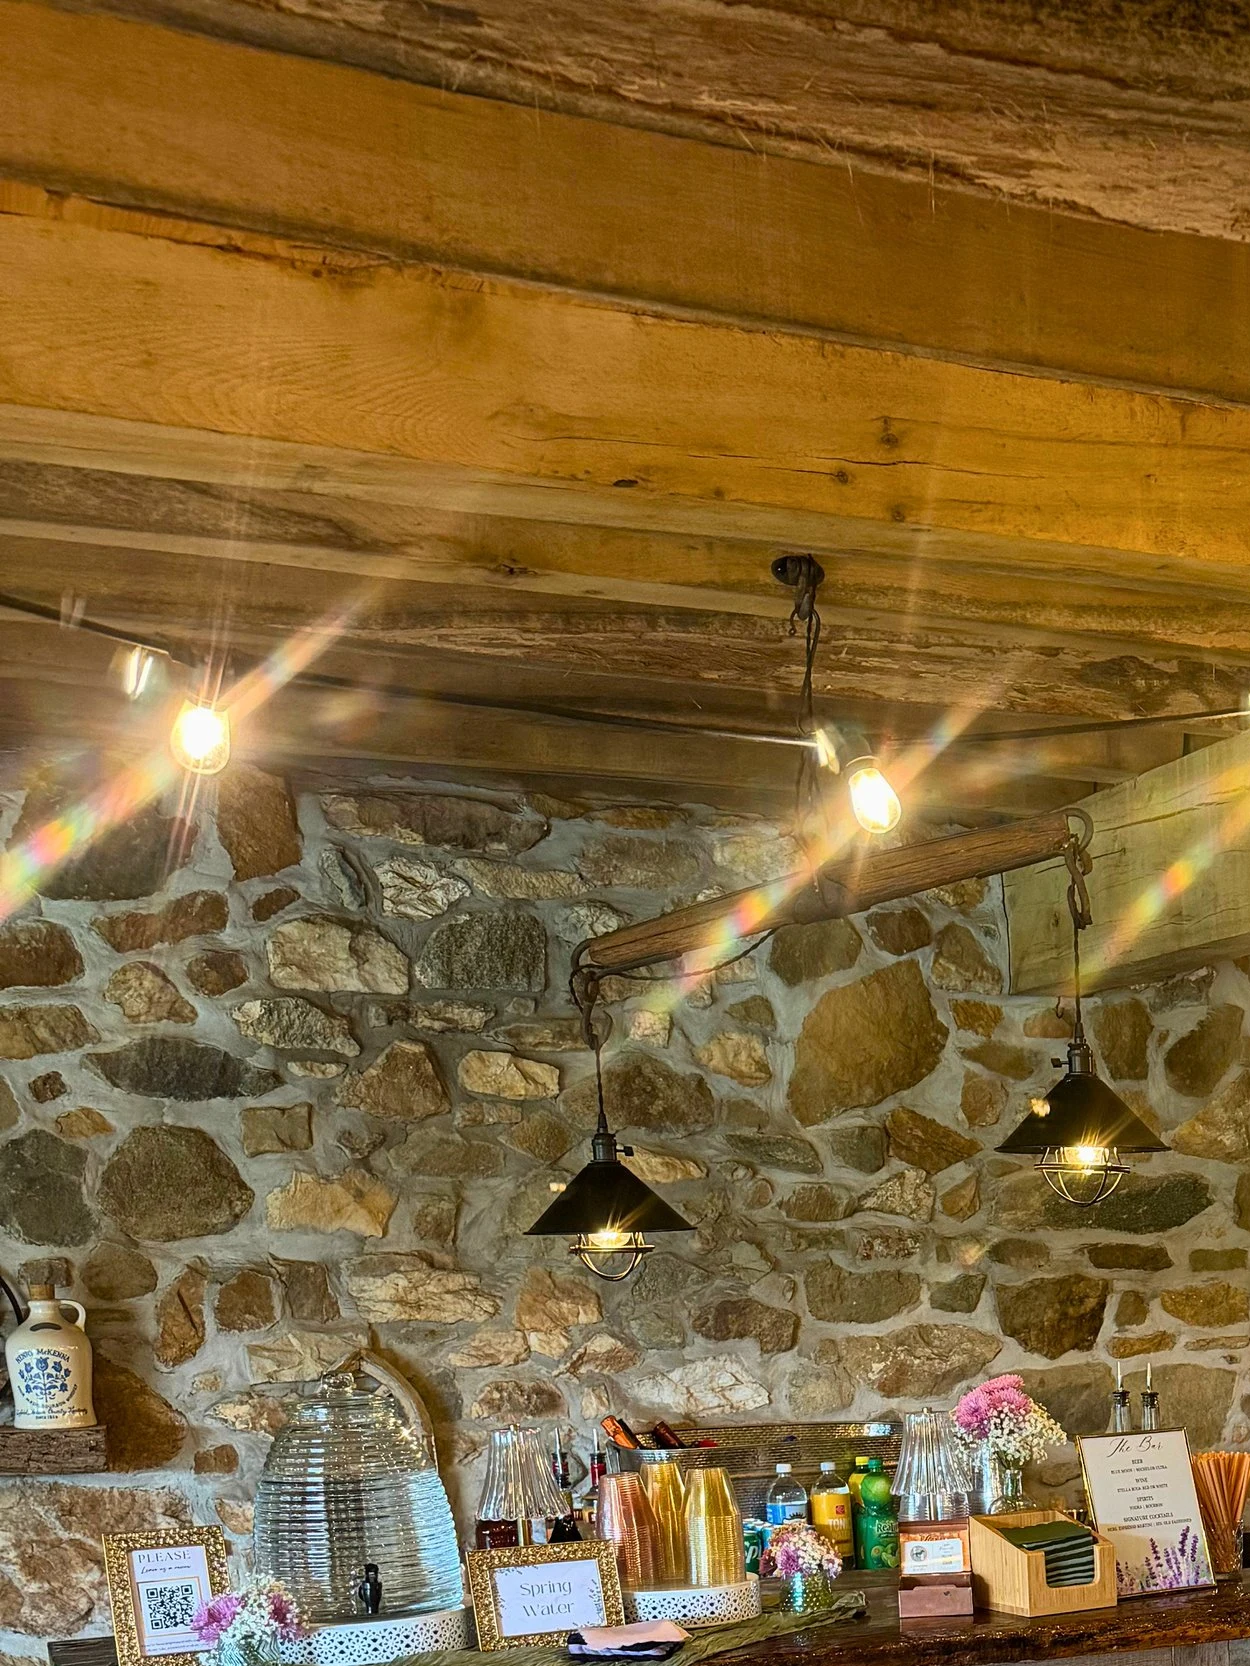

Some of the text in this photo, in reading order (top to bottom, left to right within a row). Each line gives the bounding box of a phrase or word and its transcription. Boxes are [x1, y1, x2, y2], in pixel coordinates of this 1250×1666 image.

[37, 1348, 70, 1363] McKENNA
[1106, 1435, 1164, 1458] The Bar
[1150, 1512, 1174, 1520] COCKTAILS
[138, 1549, 191, 1564] PLEASE
[520, 1581, 572, 1597] Spring
[523, 1602, 574, 1617] Water
